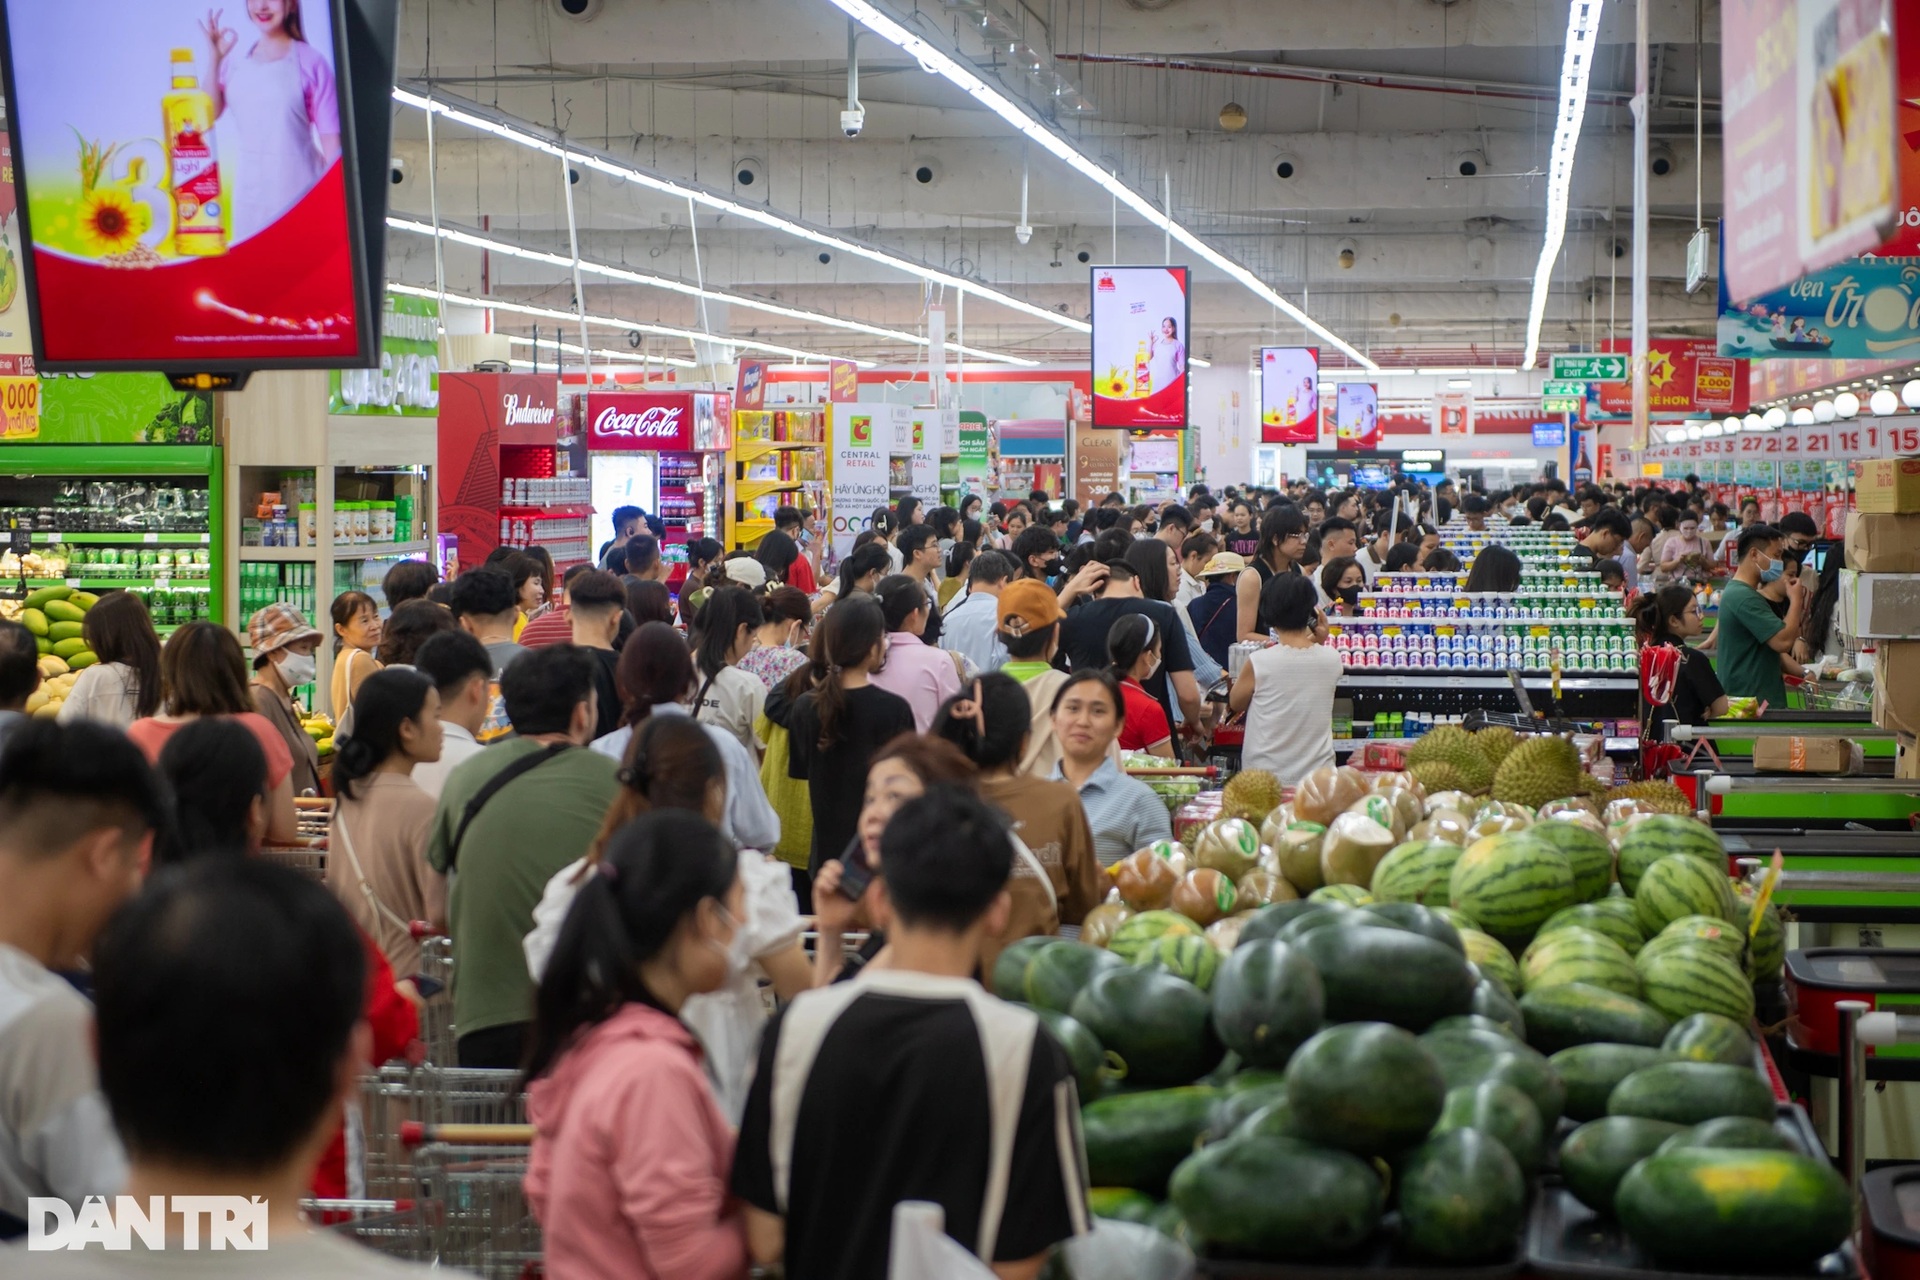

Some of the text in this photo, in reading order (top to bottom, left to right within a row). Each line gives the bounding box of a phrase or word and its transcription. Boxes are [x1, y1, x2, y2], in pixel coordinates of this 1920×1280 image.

[1563, 369, 1582, 377] EXIT
[1699, 378, 1731, 387] 2.000
[1662, 395, 1689, 405] HƠN
[503, 393, 554, 426] Budweiser
[594, 406, 683, 437] Coca-Cola
[1081, 437, 1113, 447] CLEAR
[1807, 434, 1829, 451] 21
[1866, 427, 1879, 447] 1
[1888, 428, 1919, 452] 15
[1704, 441, 1720, 452] 33
[1741, 437, 1763, 451] 27
[1766, 438, 1781, 452] 2
[1786, 436, 1799, 451] 2
[840, 451, 881, 459] CENTRAL
[1620, 453, 1632, 462] 51
[846, 459, 876, 468] RETAIL
[912, 461, 927, 469] AIL
[834, 482, 887, 497] HÃY ỦNG HỘ
